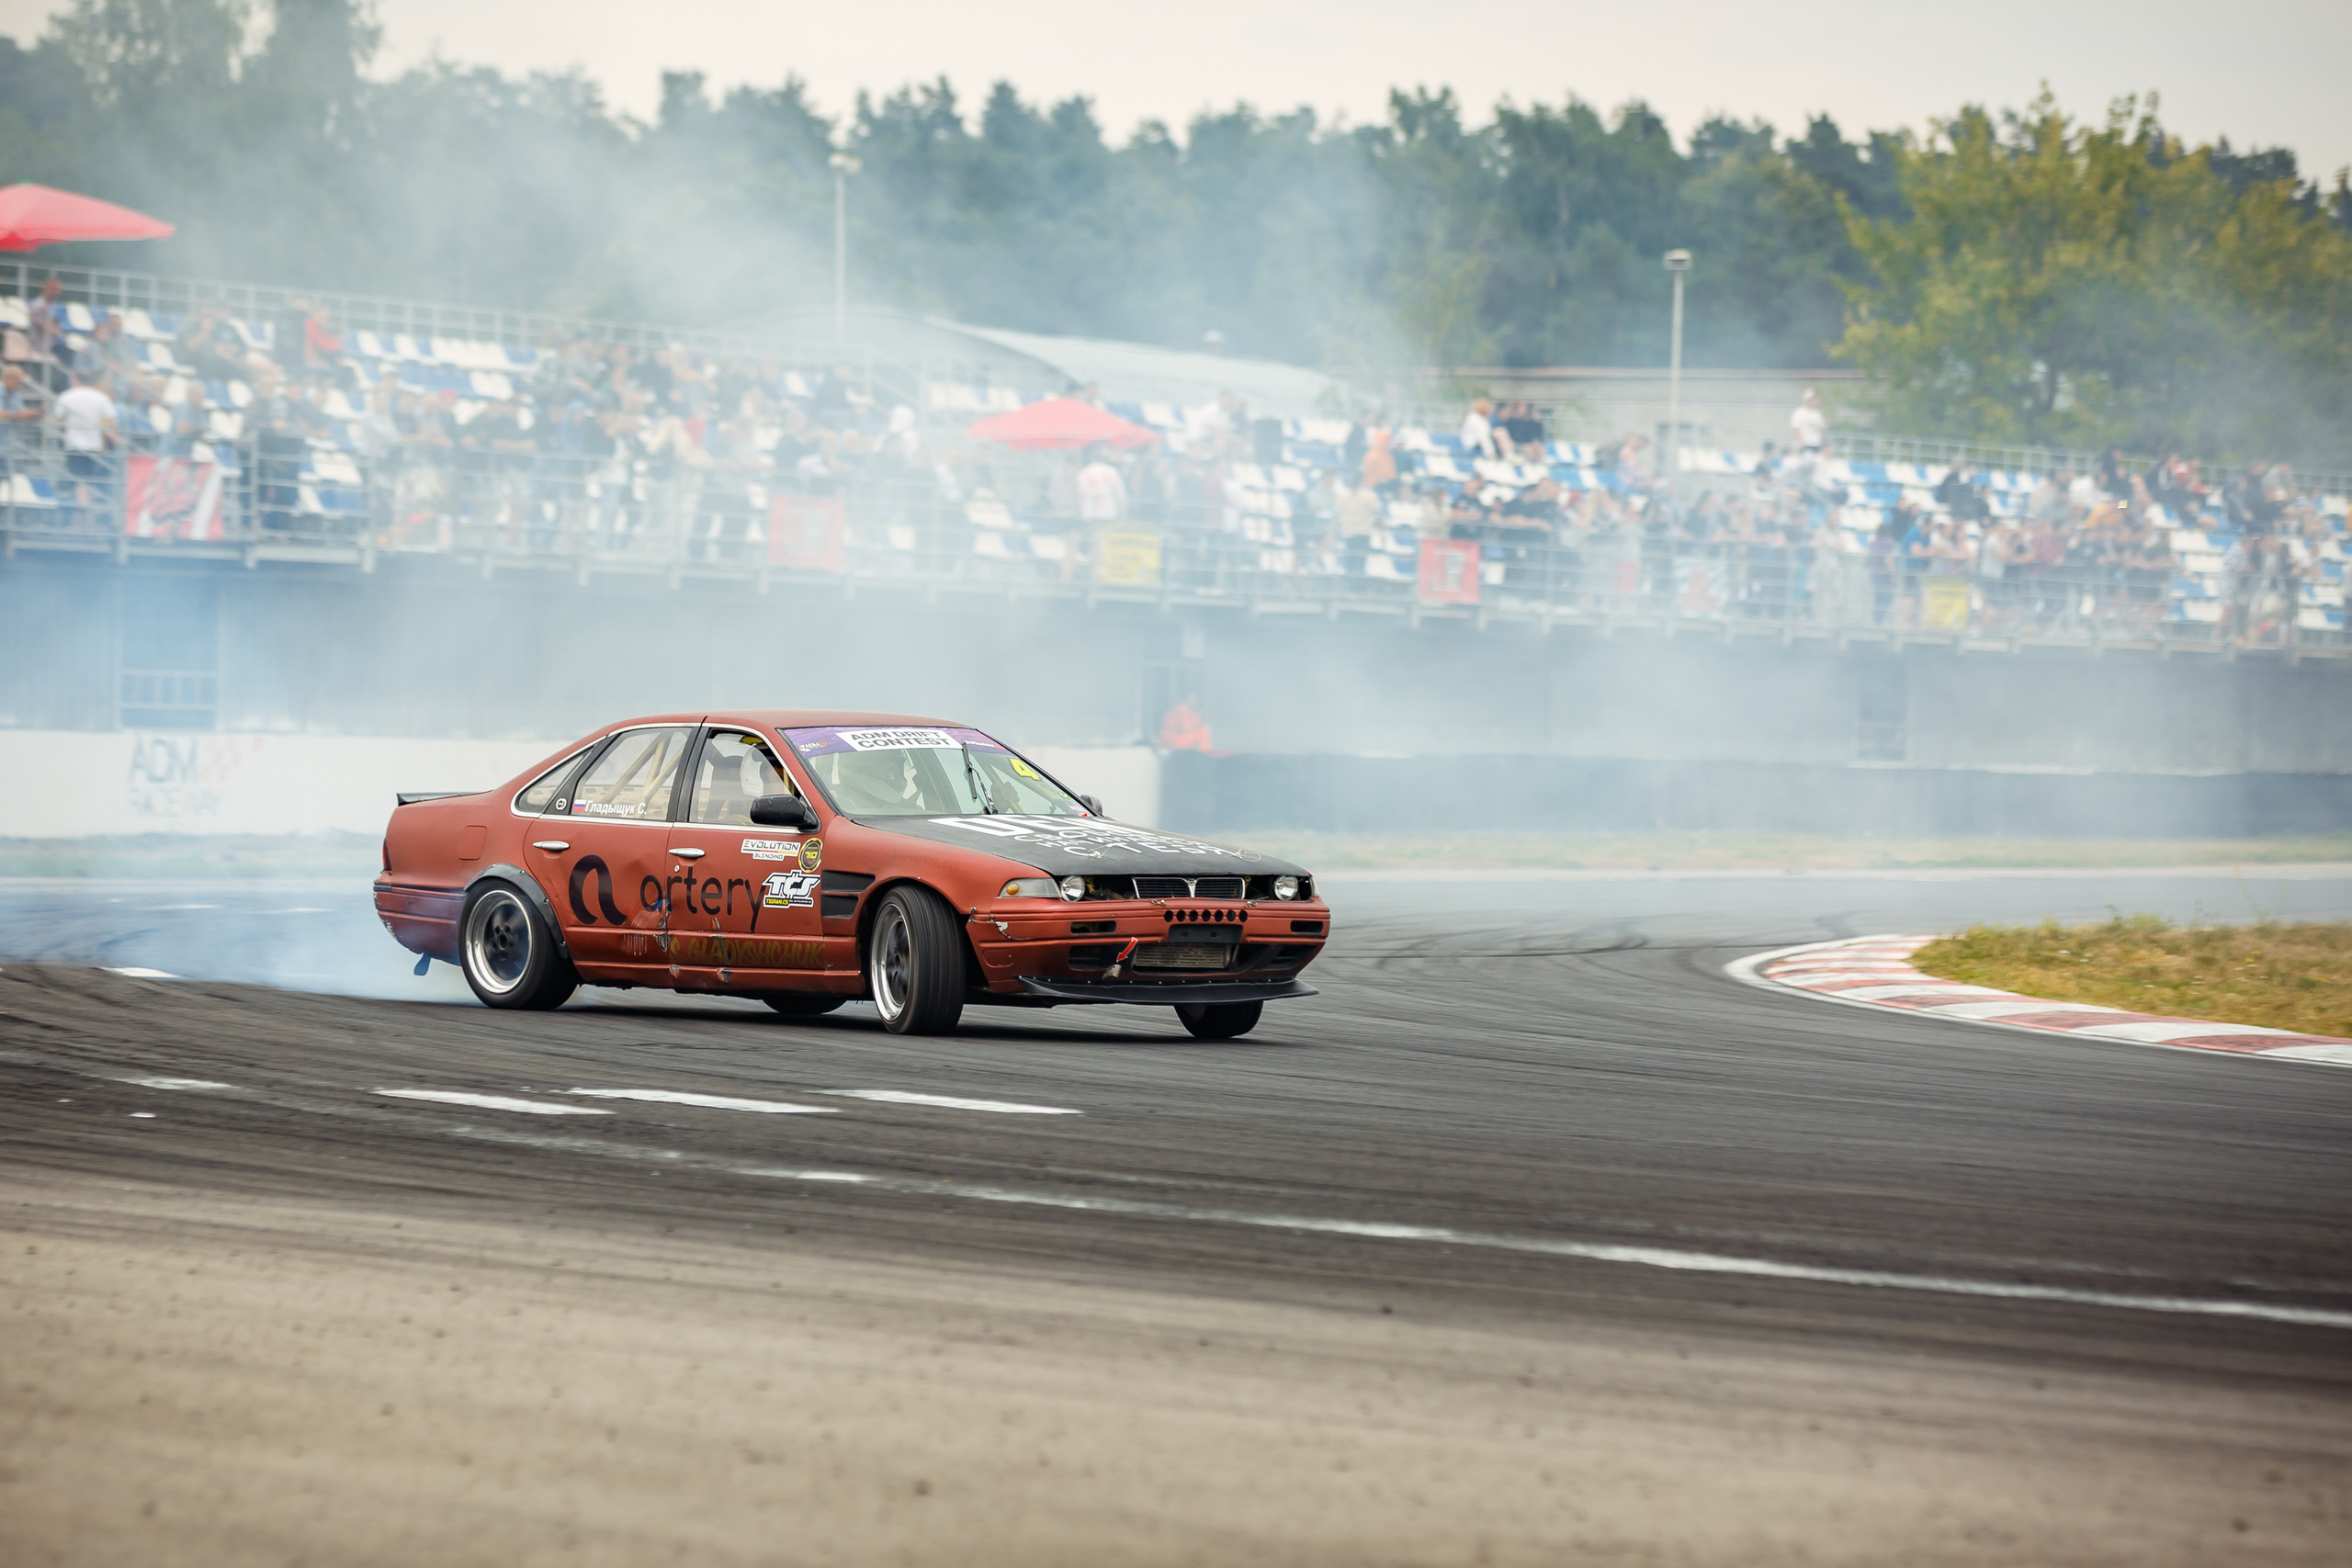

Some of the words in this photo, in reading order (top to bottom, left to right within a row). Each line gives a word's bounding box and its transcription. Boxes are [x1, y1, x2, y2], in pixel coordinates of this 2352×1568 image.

[851, 731, 891, 741] ADM
[857, 738, 951, 748] CONTEST
[1010, 758, 1040, 781] 4
[584, 801, 636, 817] Гладыщук
[638, 802, 647, 815] С.
[743, 840, 799, 851] EVOLUTION
[1105, 842, 1236, 856] ТЕБЯ
[768, 873, 820, 898] TCS
[687, 937, 825, 967] GLADYSHCHUK
